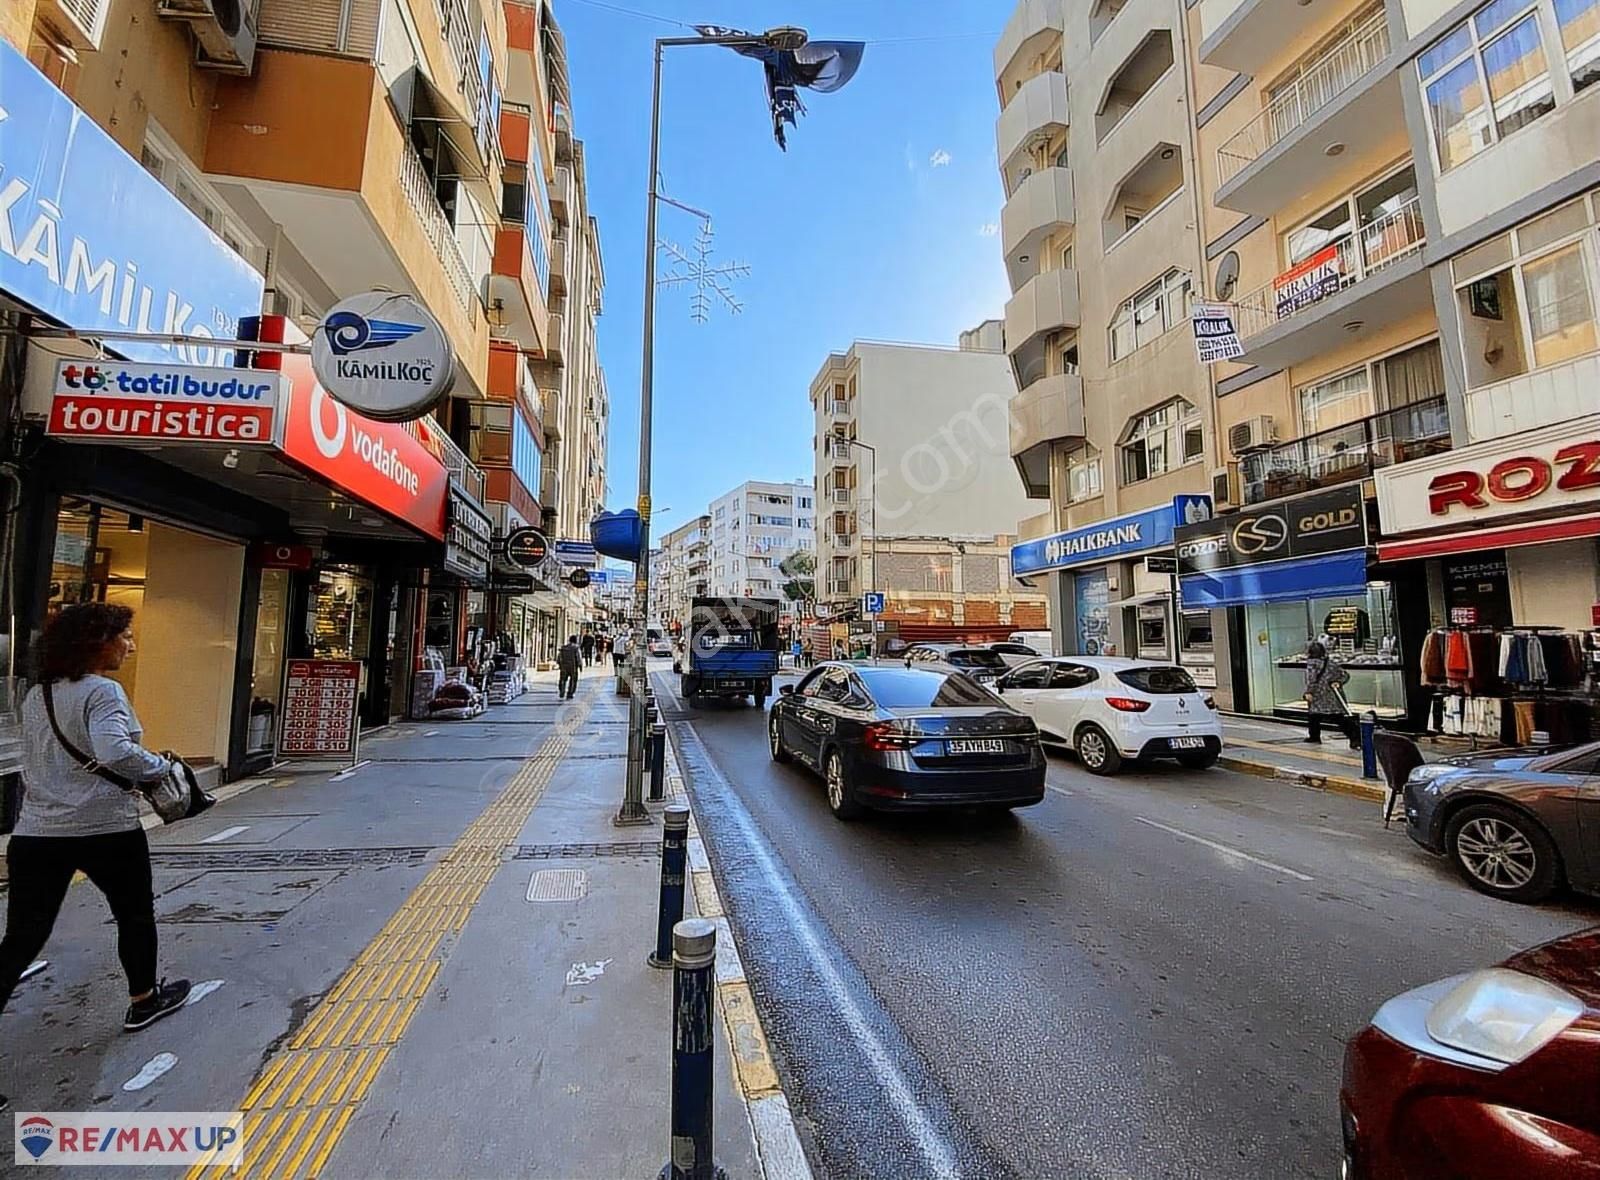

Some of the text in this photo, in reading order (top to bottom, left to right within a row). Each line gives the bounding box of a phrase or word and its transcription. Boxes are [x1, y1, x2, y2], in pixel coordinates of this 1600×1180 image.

[62, 401, 261, 438] touristica
[352, 424, 420, 496] vodafone
[1299, 508, 1357, 532] GOLD
[1060, 522, 1142, 556] HALKBANK
[867, 595, 879, 611] P
